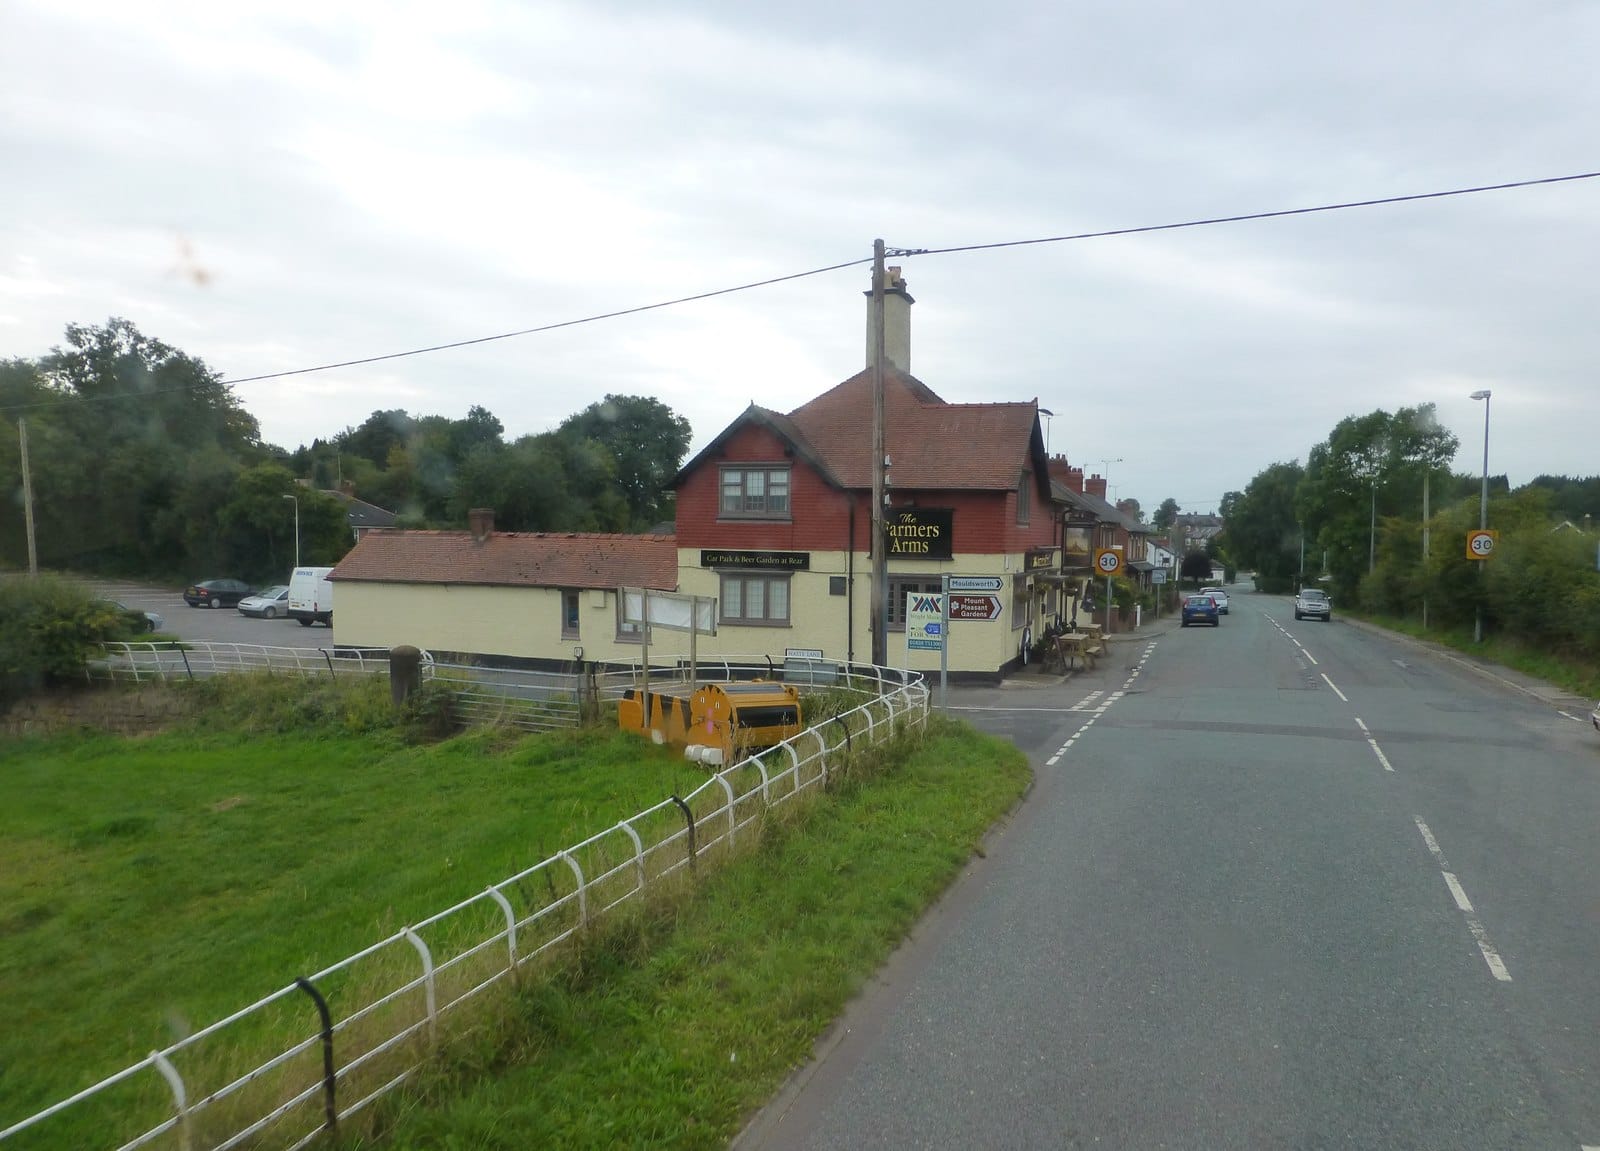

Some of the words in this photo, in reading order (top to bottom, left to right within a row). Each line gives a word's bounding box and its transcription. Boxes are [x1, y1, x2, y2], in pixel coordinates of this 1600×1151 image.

[900, 513, 916, 523] The
[891, 537, 929, 553] Arms
[1474, 540, 1491, 550] 30
[756, 556, 780, 564] Garden
[789, 557, 803, 565] Rear
[1101, 557, 1116, 566] 30
